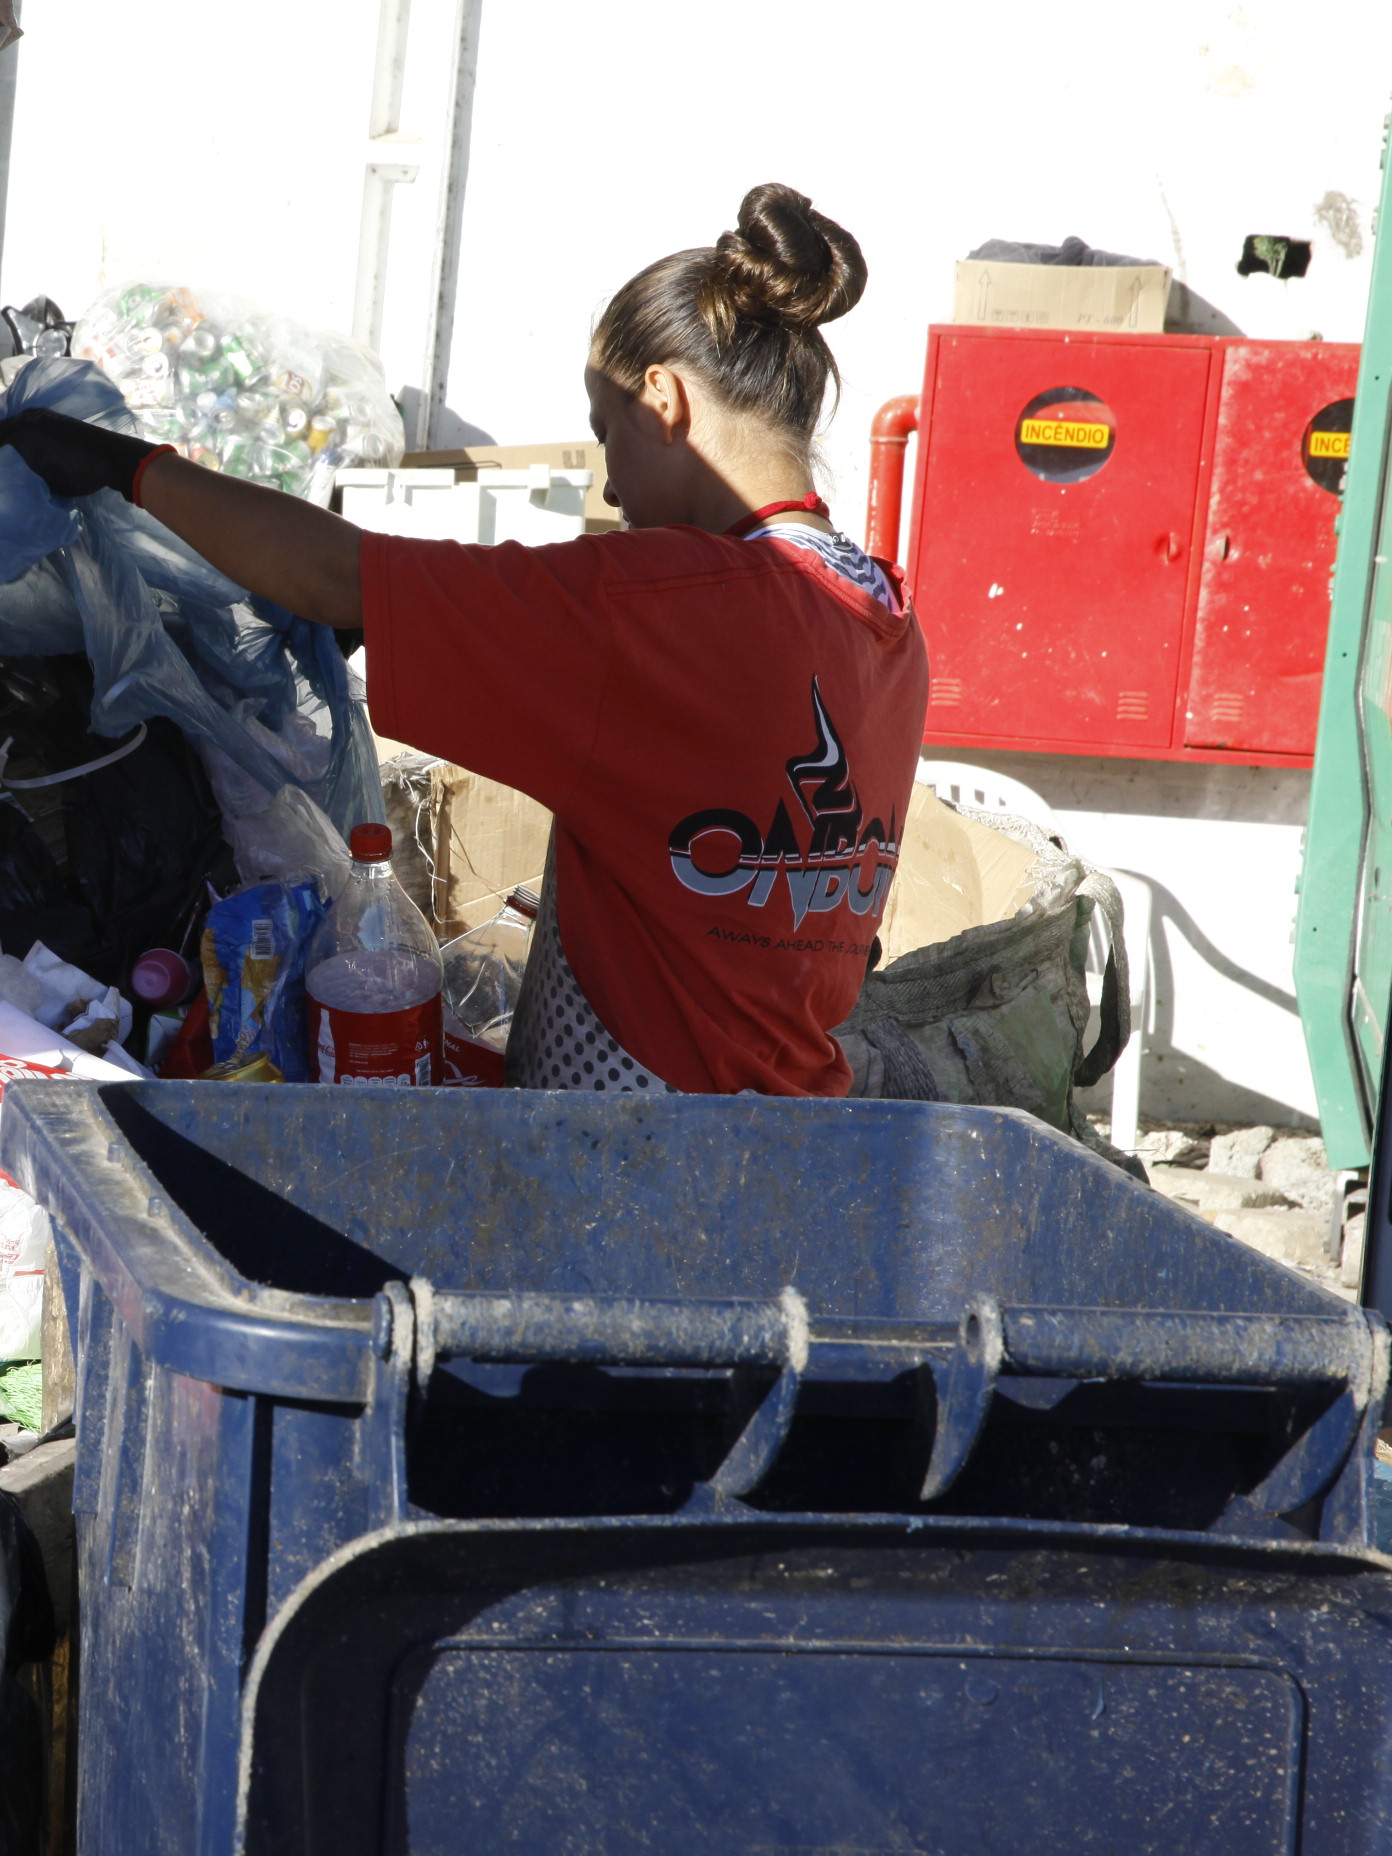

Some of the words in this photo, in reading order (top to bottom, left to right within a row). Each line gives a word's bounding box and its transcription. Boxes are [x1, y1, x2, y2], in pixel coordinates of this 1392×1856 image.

[1025, 422, 1105, 444] INCÊNDIO
[708, 927, 771, 948] AWAYS
[775, 939, 824, 951] AHEAD
[828, 942, 844, 951] THE
